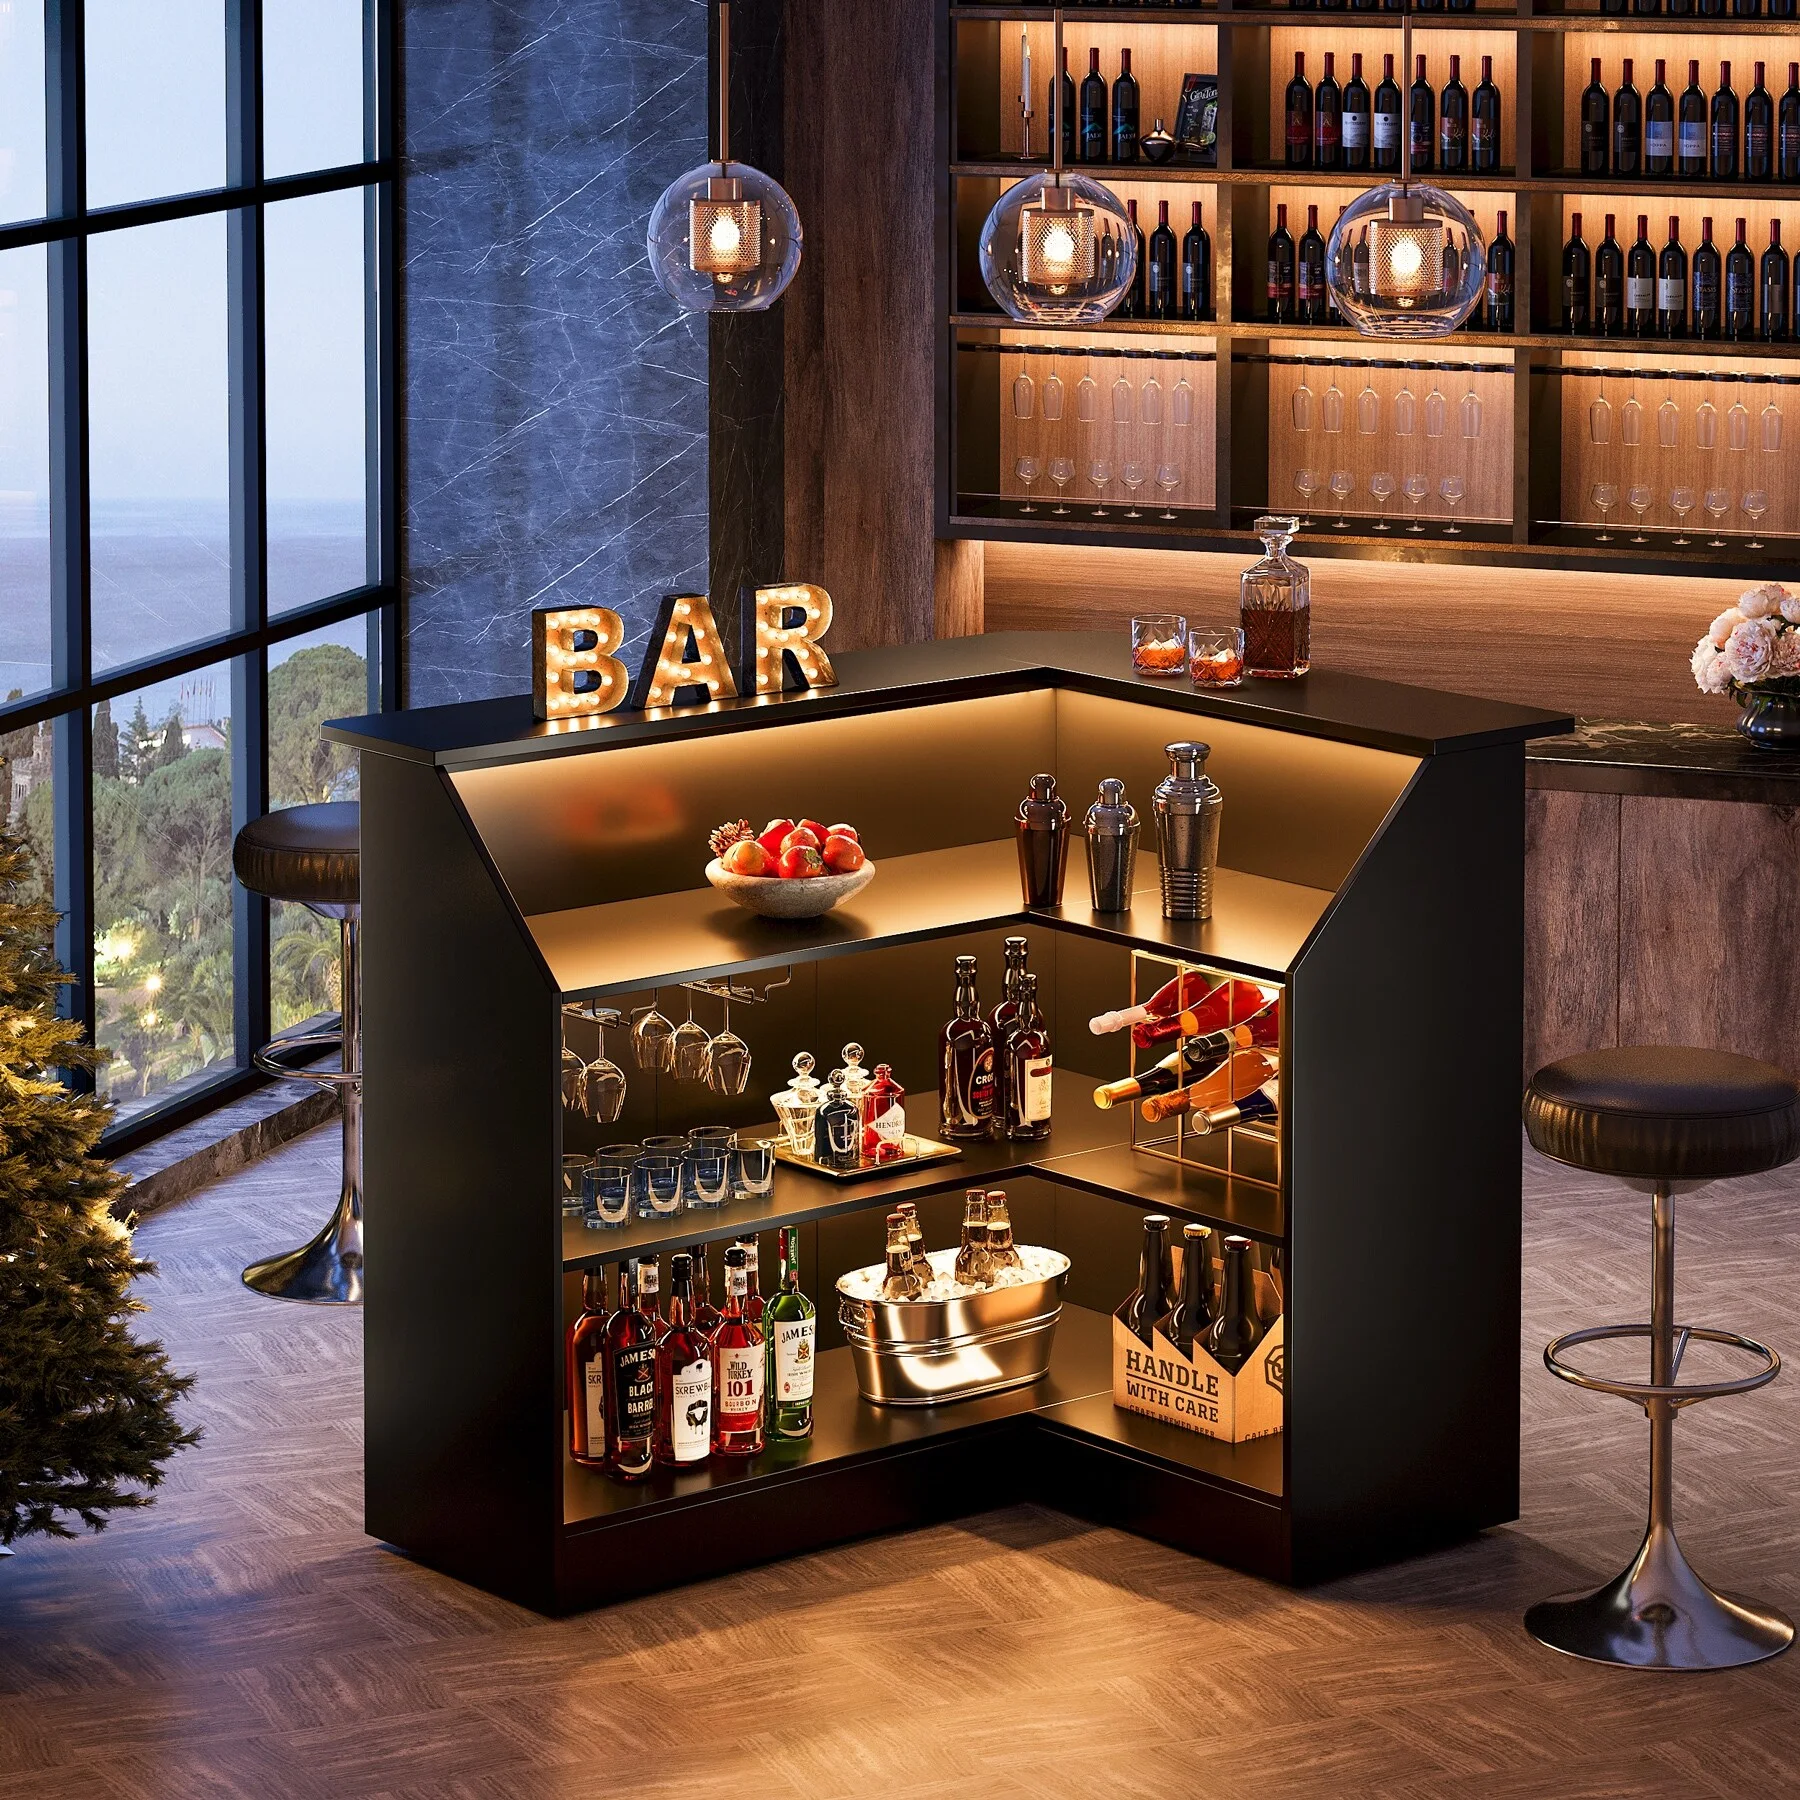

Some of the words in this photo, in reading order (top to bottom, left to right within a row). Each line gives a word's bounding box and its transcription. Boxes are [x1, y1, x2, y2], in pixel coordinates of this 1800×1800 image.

[1731, 286, 1752, 294] STASIS
[532, 584, 839, 720] BAR
[729, 1361, 747, 1370] WILD
[1126, 1349, 1219, 1397] HANDLE
[727, 1369, 753, 1380] TURKEY
[727, 1380, 754, 1397] 101
[724, 1399, 756, 1408] BOURBON
[1126, 1380, 1169, 1407] WITH
[1175, 1395, 1219, 1423] CARE
[1129, 1404, 1156, 1419] CRAFT
[1158, 1414, 1192, 1430] BREWED
